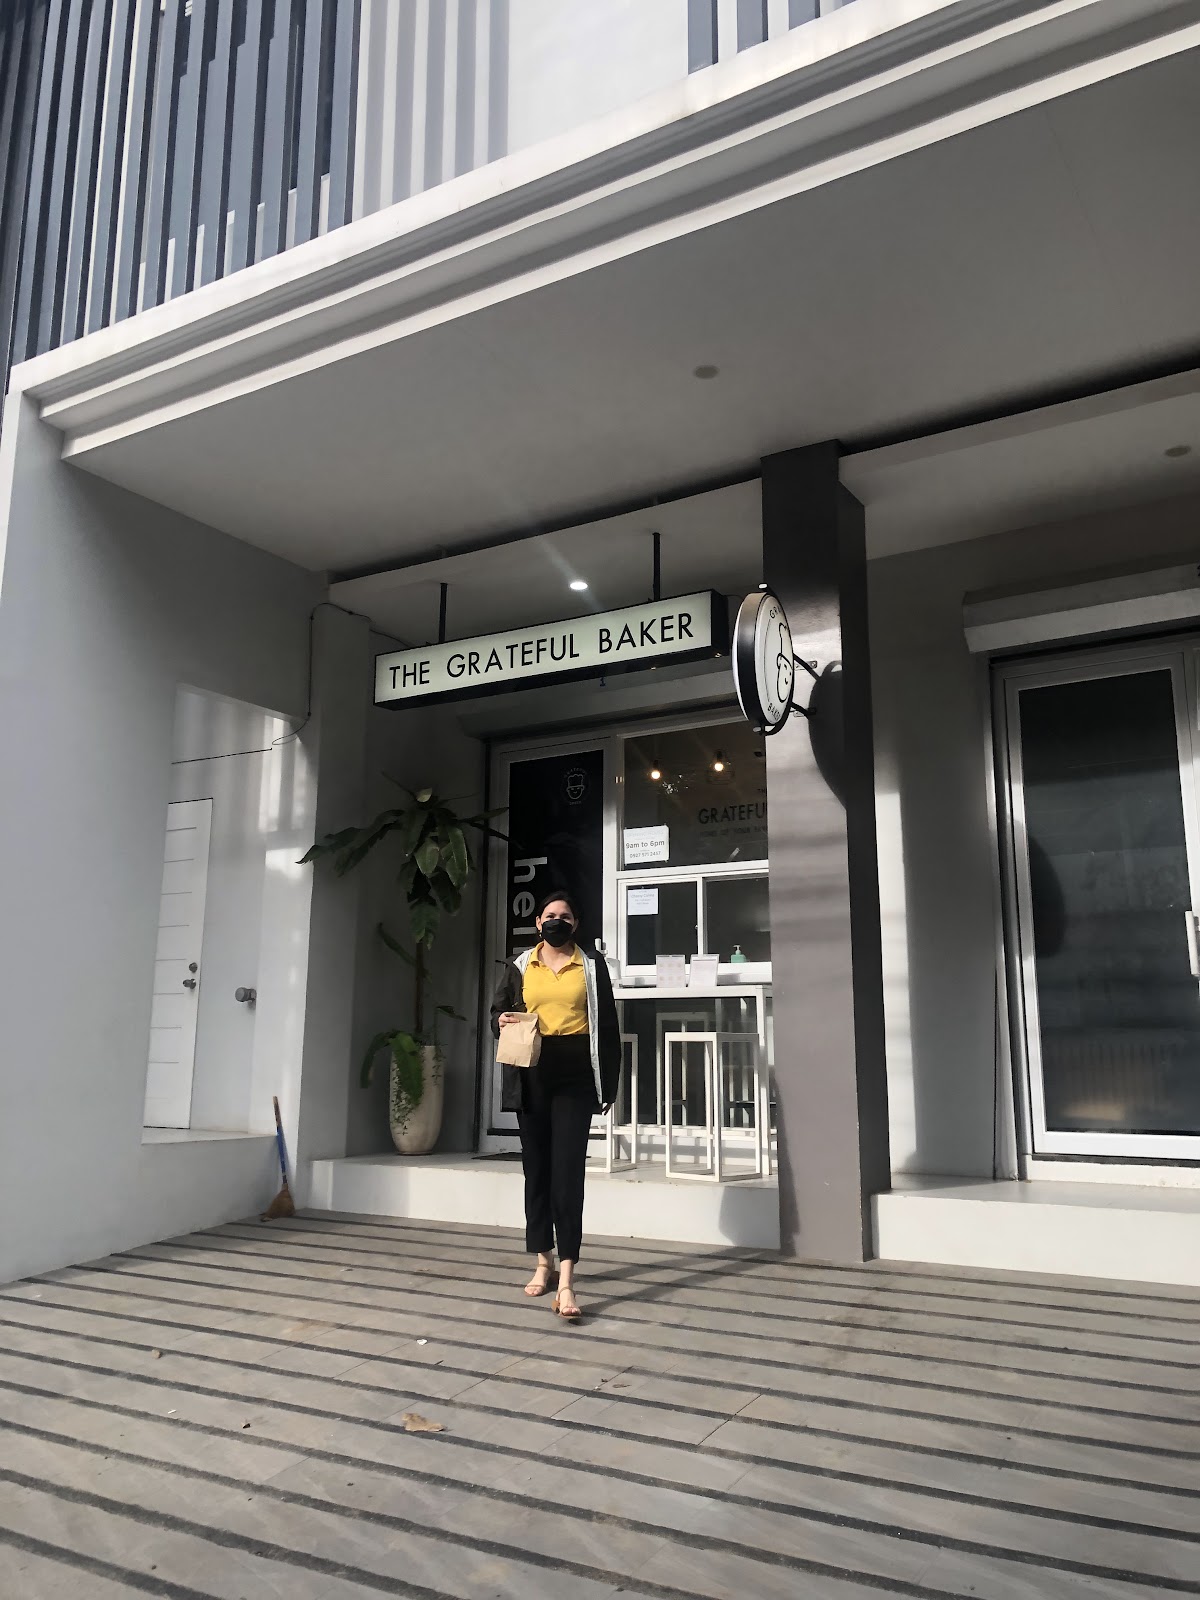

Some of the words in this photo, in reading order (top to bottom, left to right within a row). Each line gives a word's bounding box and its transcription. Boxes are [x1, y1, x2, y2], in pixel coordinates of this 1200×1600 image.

[389, 660, 430, 689] THE
[446, 633, 580, 678] GRATEFUL
[599, 612, 694, 654] BAKER
[698, 802, 766, 824] GRATEFU
[512, 856, 548, 955] hel
